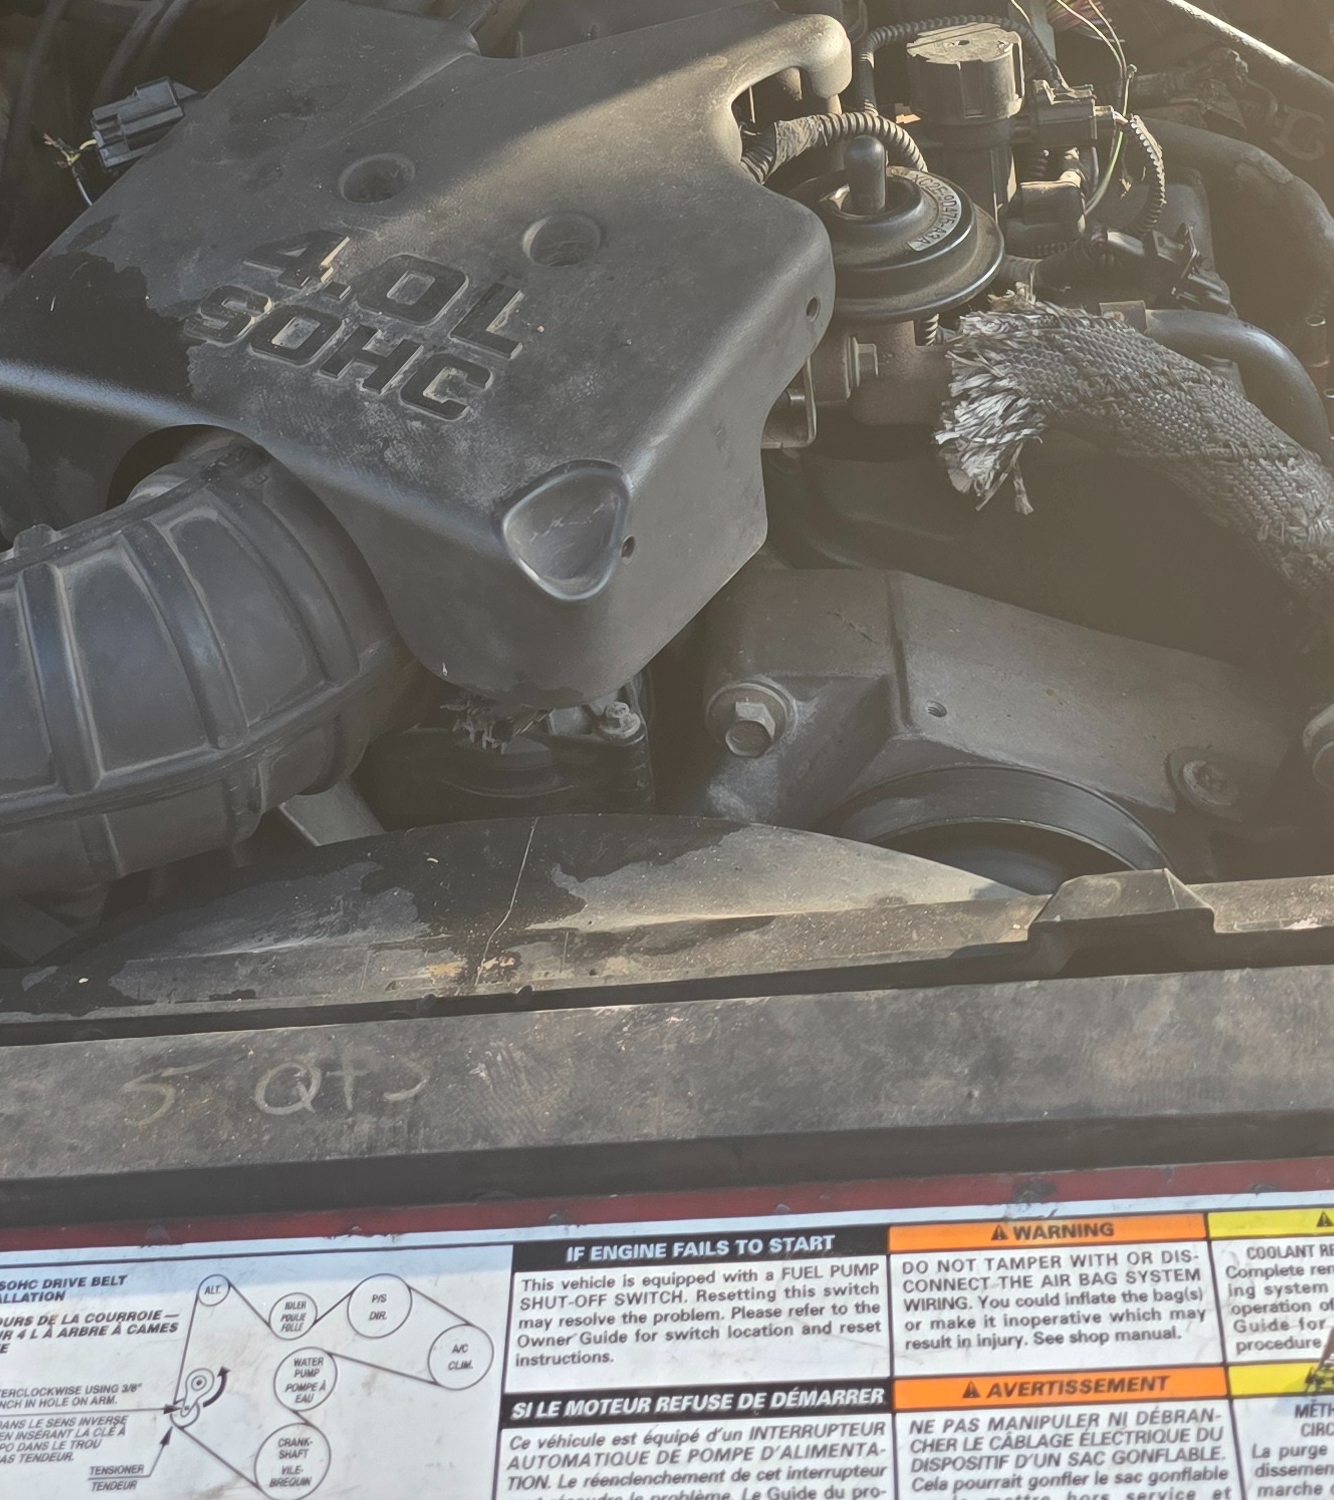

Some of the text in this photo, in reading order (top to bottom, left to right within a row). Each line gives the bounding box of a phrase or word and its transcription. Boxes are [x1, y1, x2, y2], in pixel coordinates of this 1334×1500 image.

[243, 236, 524, 360] 4.0L
[183, 285, 493, 421] SOHC
[1012, 1222, 1115, 1241] WARNING
[566, 1234, 836, 1263] IF ENGINE FAILS TO START
[1246, 1243, 1315, 1261] COOLANT
[902, 1248, 1199, 1275] DO NOT TAMPER WITH OR DIS-
[42, 1277, 87, 1290] DRIVE
[91, 1274, 128, 1287] BELT
[521, 1262, 879, 1293] This vehicle is equipped with a FUEL PUMP
[1226, 1263, 1305, 1284] Complete
[204, 1285, 222, 1295] ALT.
[371, 1294, 387, 1304] P/S
[284, 1300, 306, 1311] IDLER
[38, 1314, 58, 1327] DE
[60, 1313, 80, 1325] LA
[84, 1309, 164, 1324] COURROIE
[17, 1330, 26, 1340] 4
[29, 1329, 39, 1339] L
[57, 1324, 108, 1338] ARBRE
[111, 1320, 123, 1334] À
[127, 1321, 180, 1336] CAMES
[452, 1344, 468, 1354] A/C
[293, 1357, 324, 1368] WATER
[294, 1368, 320, 1379] PUMP
[85, 1384, 119, 1395] USING
[986, 1375, 1171, 1399] AVERTISSEMENT
[510, 1386, 885, 1420] SI LE MOTEUR REFUSE DE DÉMARRER
[278, 1437, 313, 1448] CRANK-
[279, 1448, 309, 1460] SHAFT
[89, 1464, 144, 1476] TENSIONER
